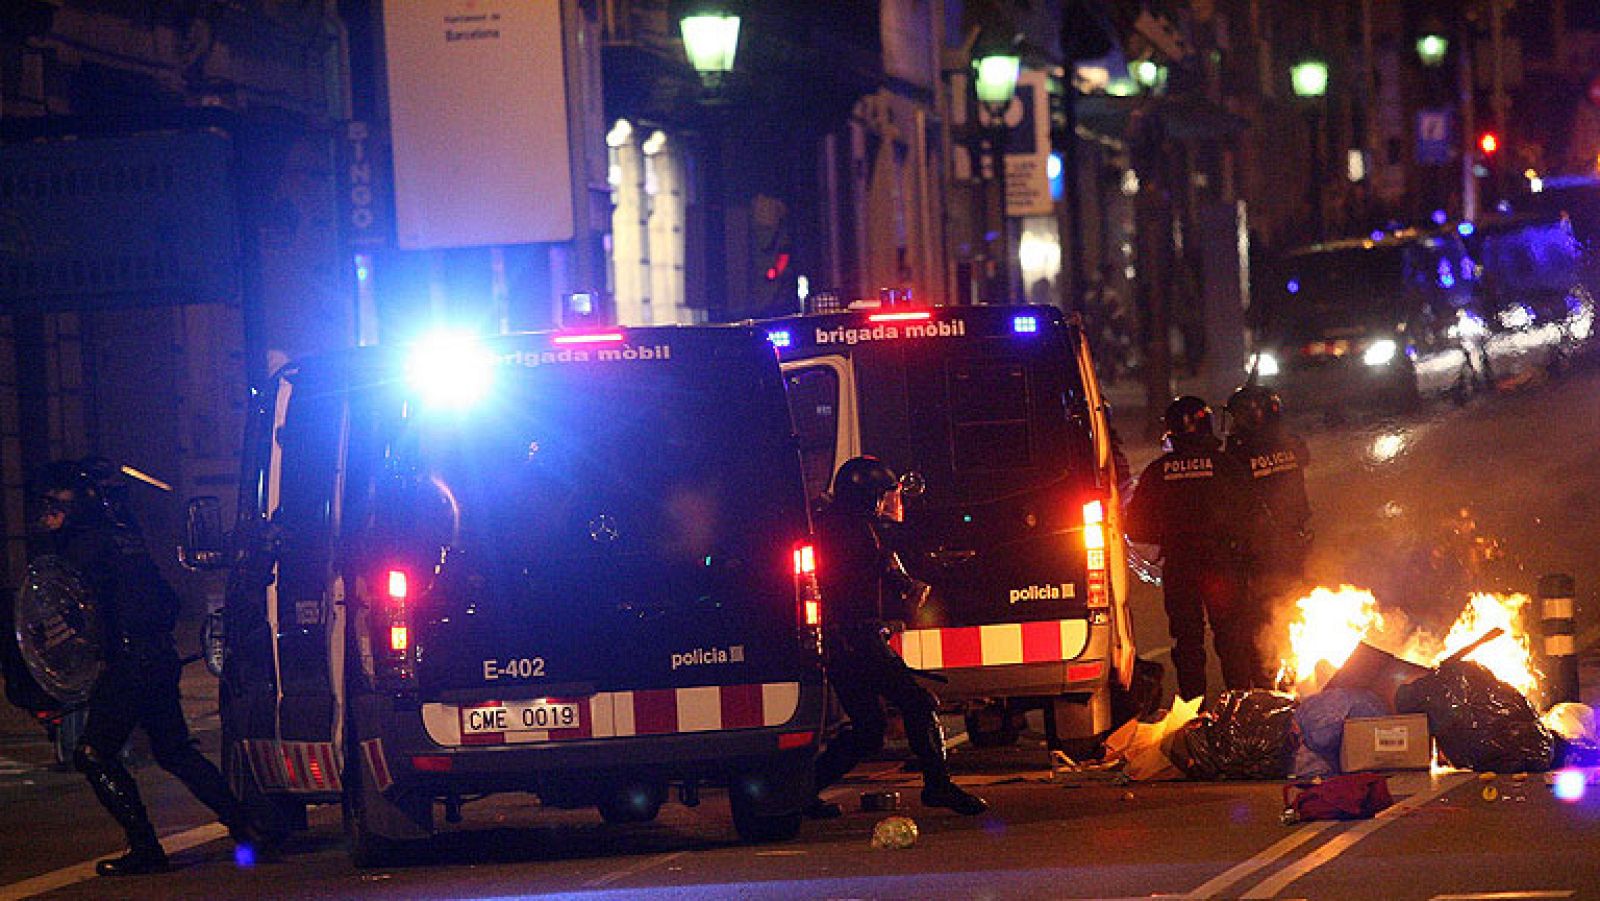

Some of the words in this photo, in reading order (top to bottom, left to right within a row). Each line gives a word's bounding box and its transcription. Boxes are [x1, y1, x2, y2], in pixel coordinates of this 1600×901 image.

[348, 122, 372, 229] BINGO
[815, 325, 899, 345] brigada
[905, 319, 966, 339] mòbil
[491, 349, 589, 367] rigada
[598, 344, 671, 363] mòbil
[1164, 458, 1213, 473] POLICIA
[1009, 583, 1060, 604] policia
[483, 657, 546, 680] E-402
[672, 647, 728, 670] policia
[470, 710, 508, 731] CME
[522, 706, 574, 727] 0019
